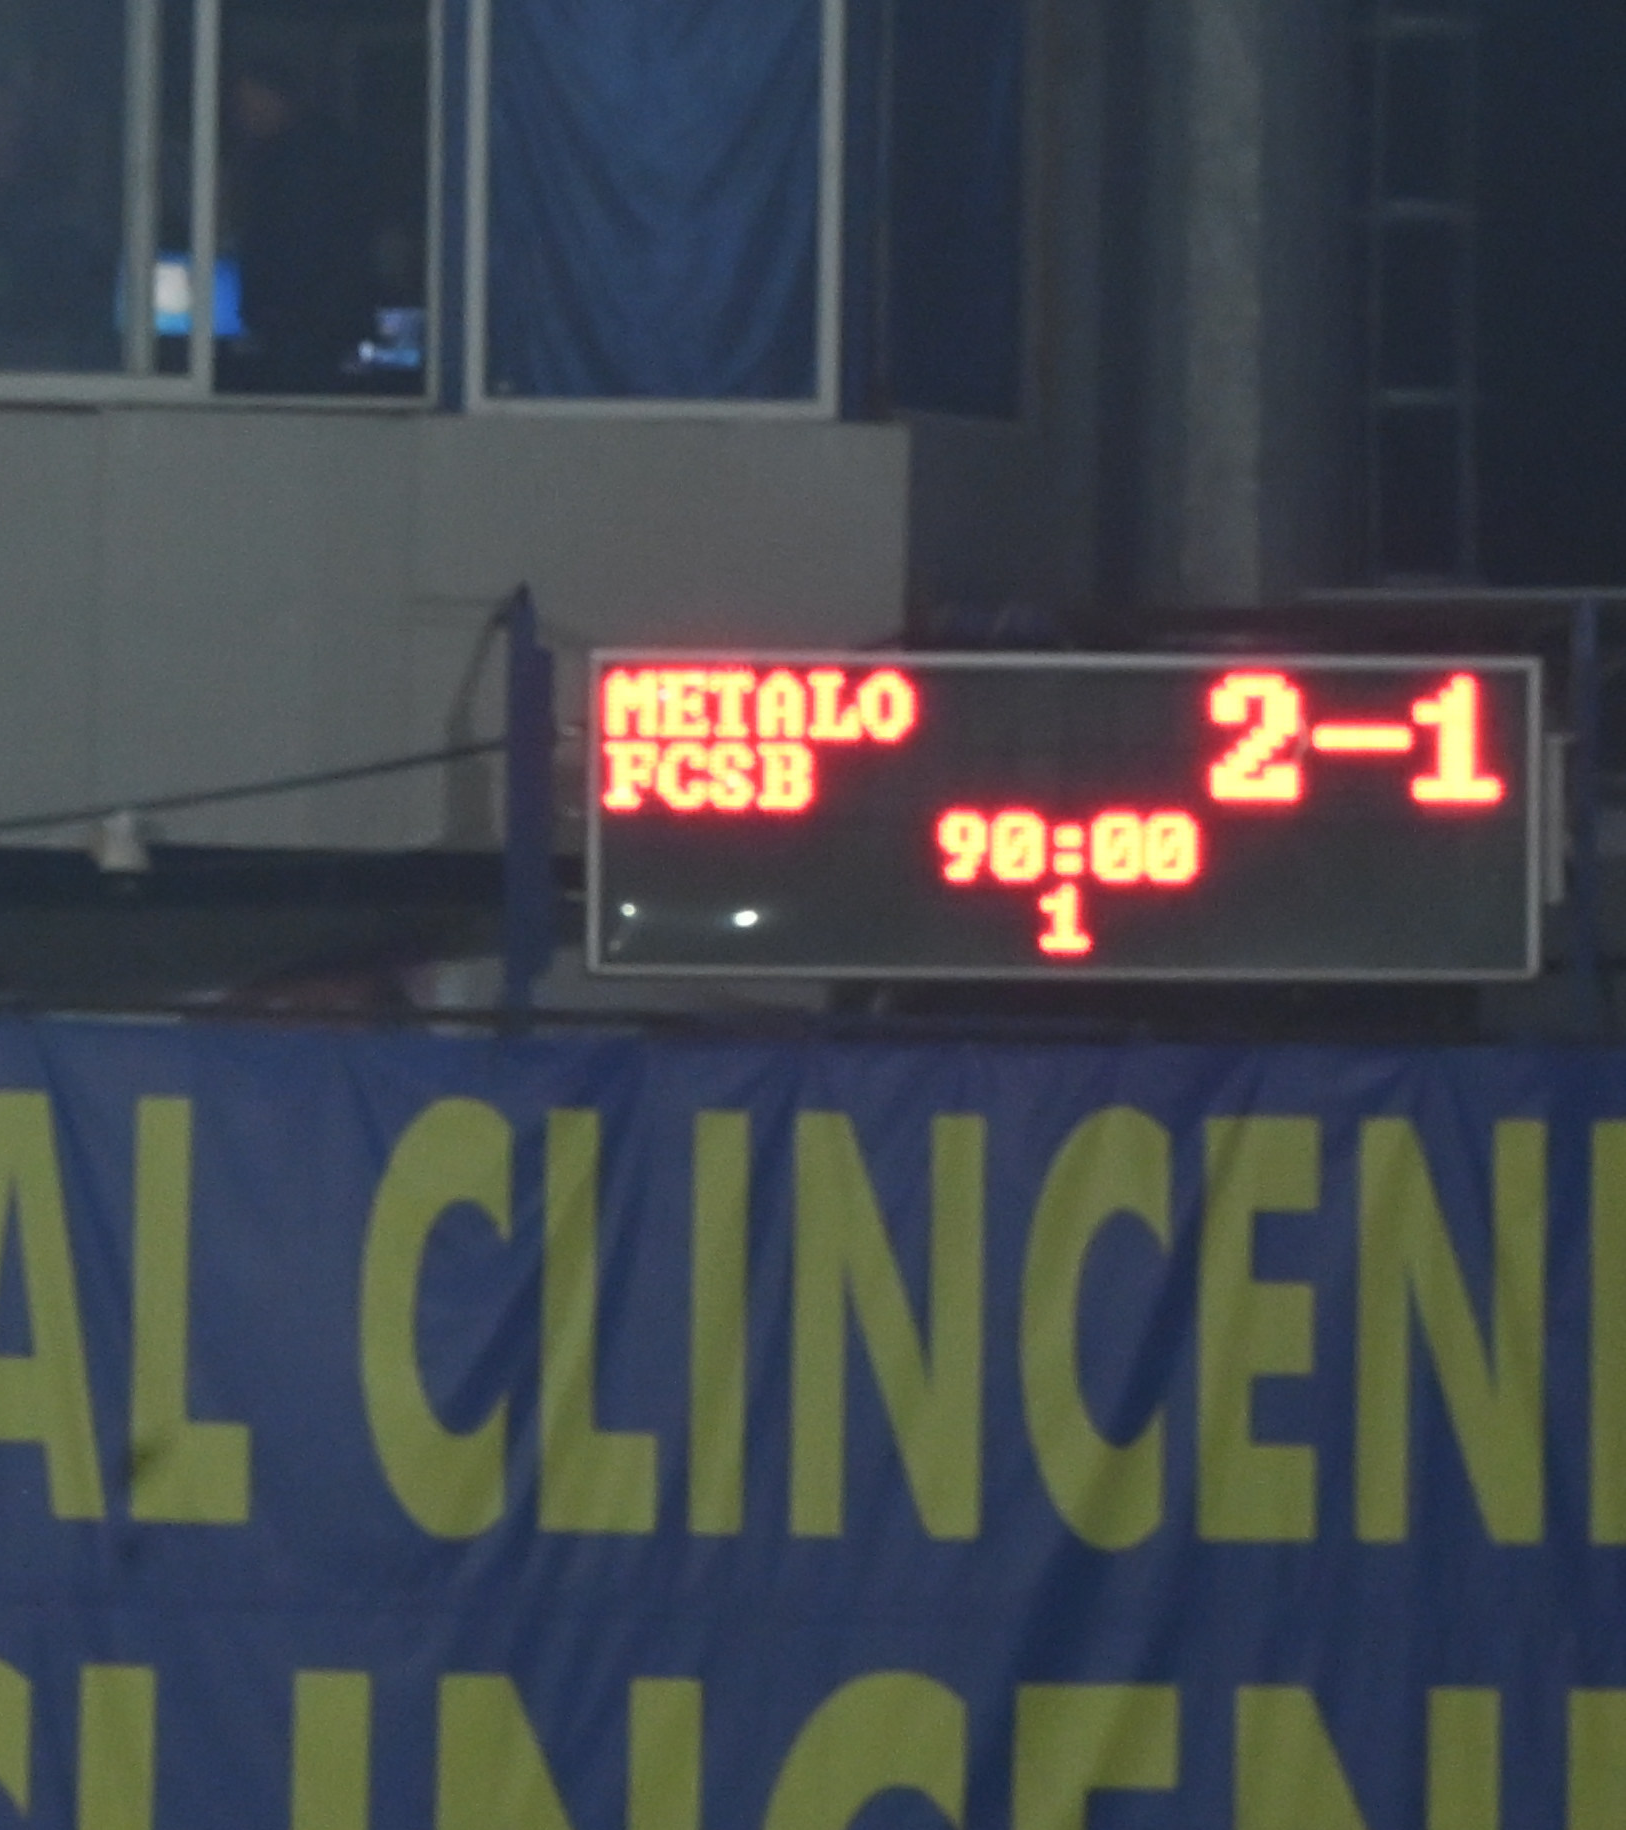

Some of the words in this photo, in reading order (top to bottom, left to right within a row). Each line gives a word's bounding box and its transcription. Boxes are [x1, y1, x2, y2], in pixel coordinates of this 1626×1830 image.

[600, 666, 919, 741] METALO
[600, 740, 816, 813] FCSB
[935, 808, 1203, 884] 90:00
[1037, 881, 1094, 957] 1
